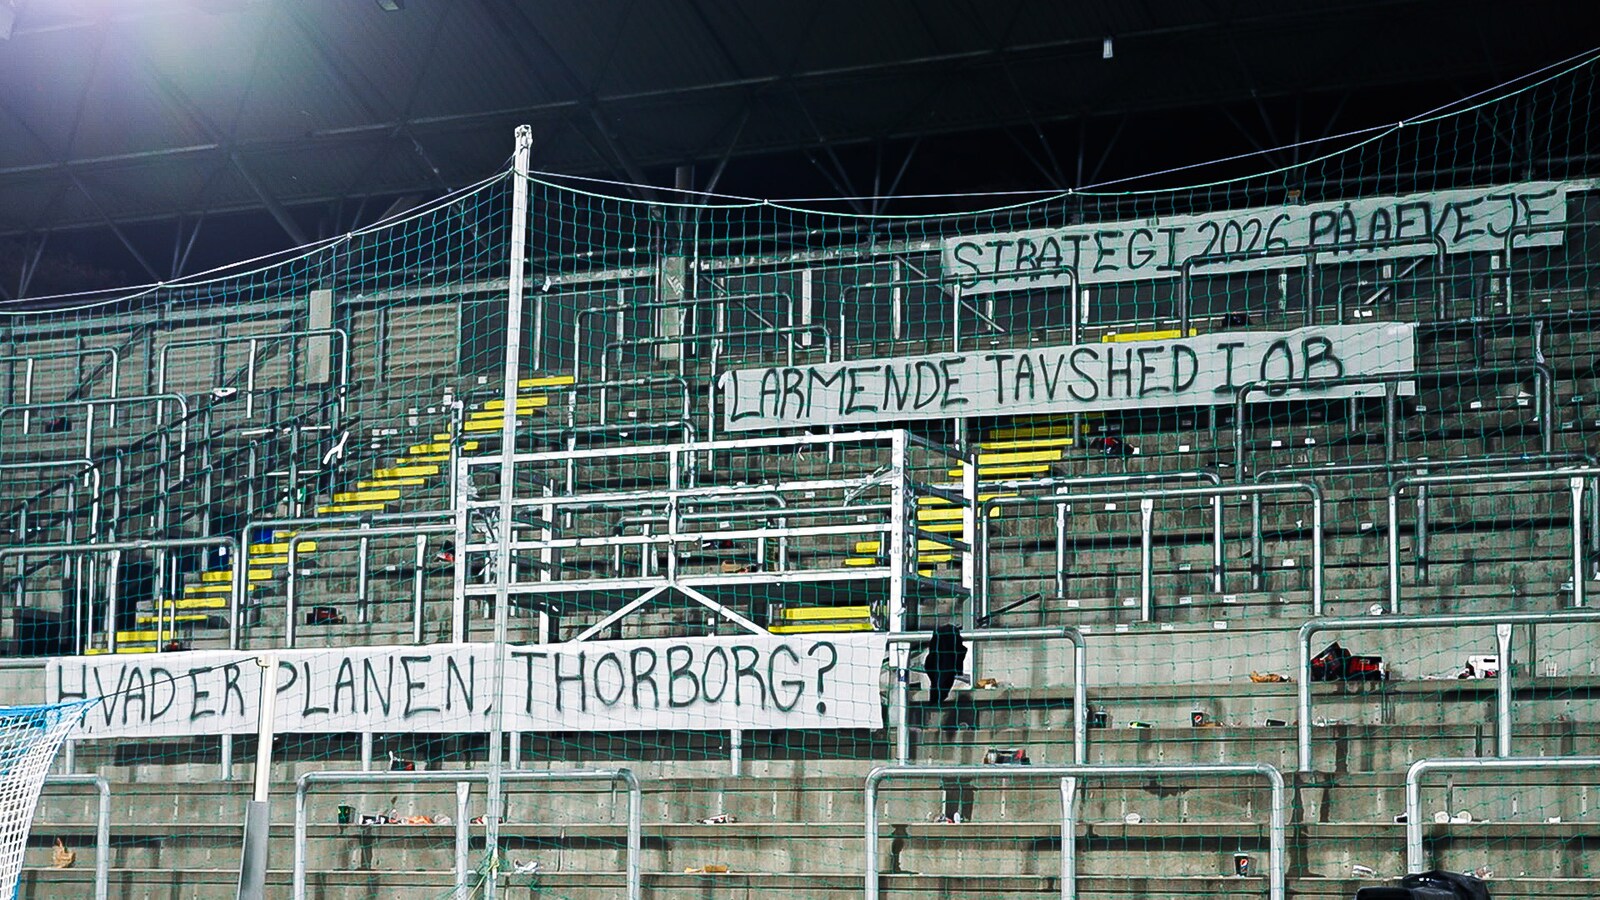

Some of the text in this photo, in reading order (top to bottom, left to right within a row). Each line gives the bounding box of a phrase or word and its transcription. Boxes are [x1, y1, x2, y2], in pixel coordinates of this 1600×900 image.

[953, 227, 1187, 288] STRATEGI
[1193, 213, 1291, 266] 2026
[1309, 202, 1357, 255] PÅ
[731, 336, 1344, 422] LARMENDE TAVSHED I OB
[57, 664, 176, 728] HVAD
[189, 664, 245, 722] ER
[511, 641, 838, 715] THORBORG?
